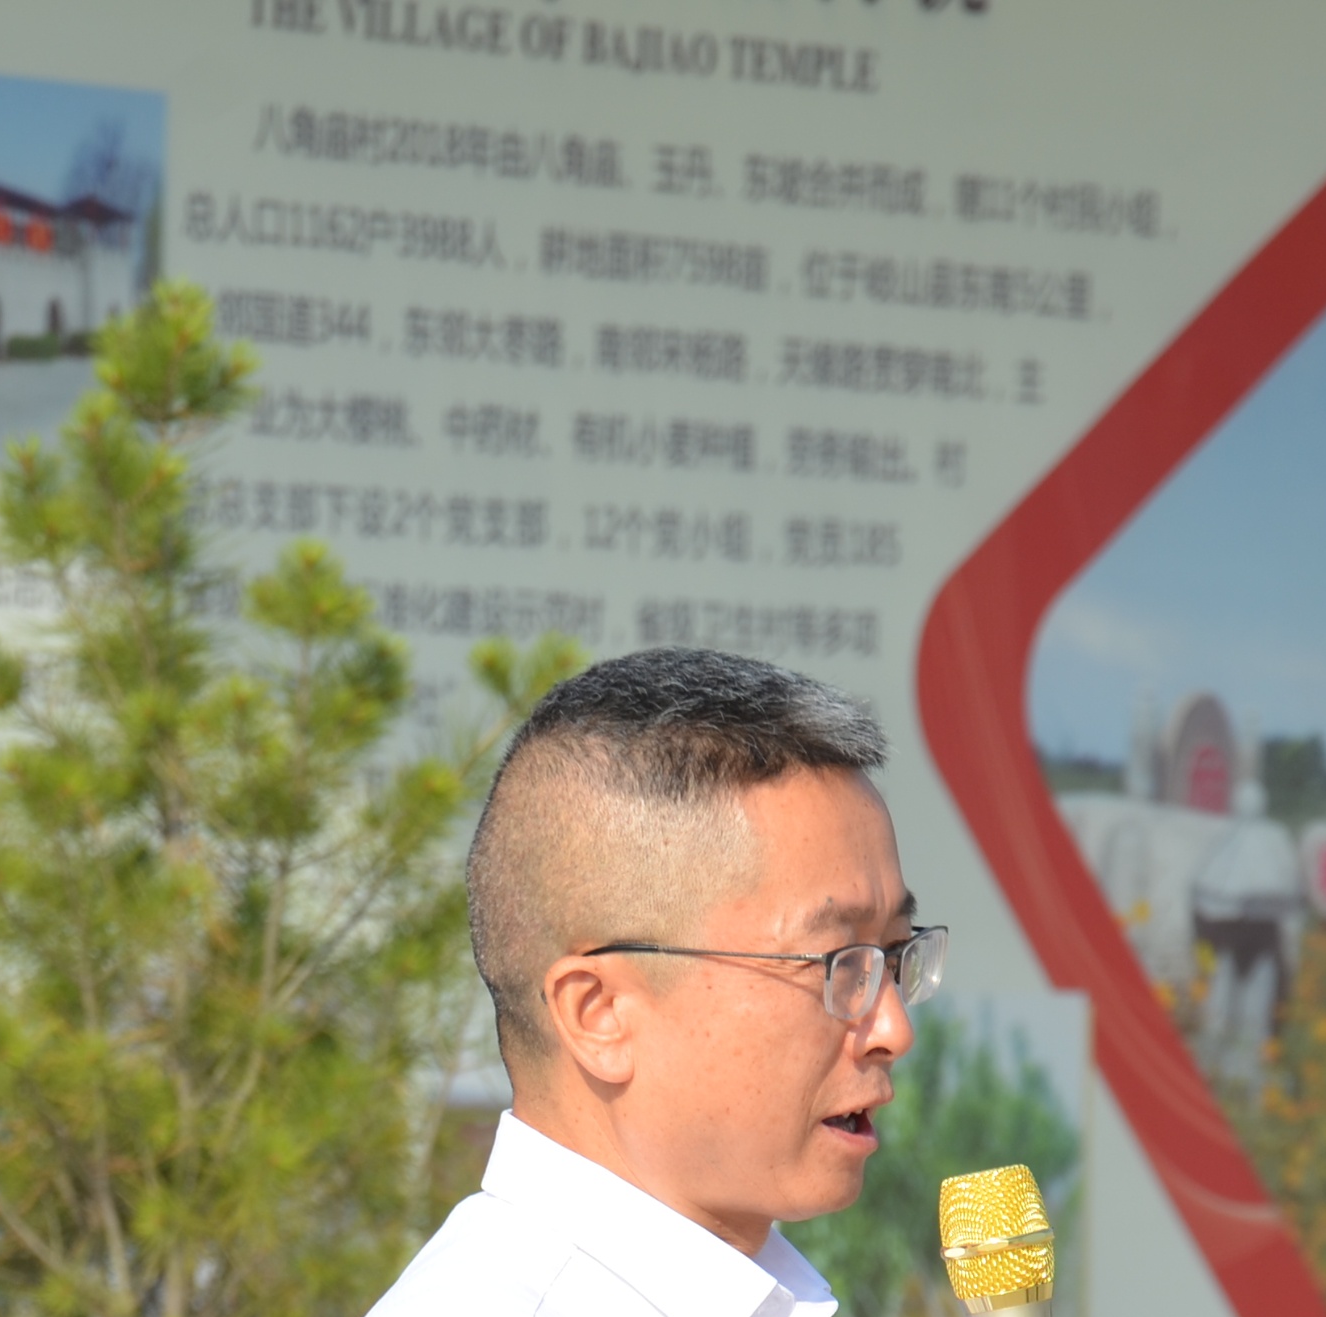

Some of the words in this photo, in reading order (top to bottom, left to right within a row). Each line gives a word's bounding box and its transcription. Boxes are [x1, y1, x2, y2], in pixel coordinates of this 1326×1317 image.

[249, 0, 325, 34] THE
[340, 0, 512, 56] VILLAGE
[520, 13, 576, 62] OF
[583, 20, 718, 78] BAJIAO
[727, 34, 880, 95] TEMPLE
